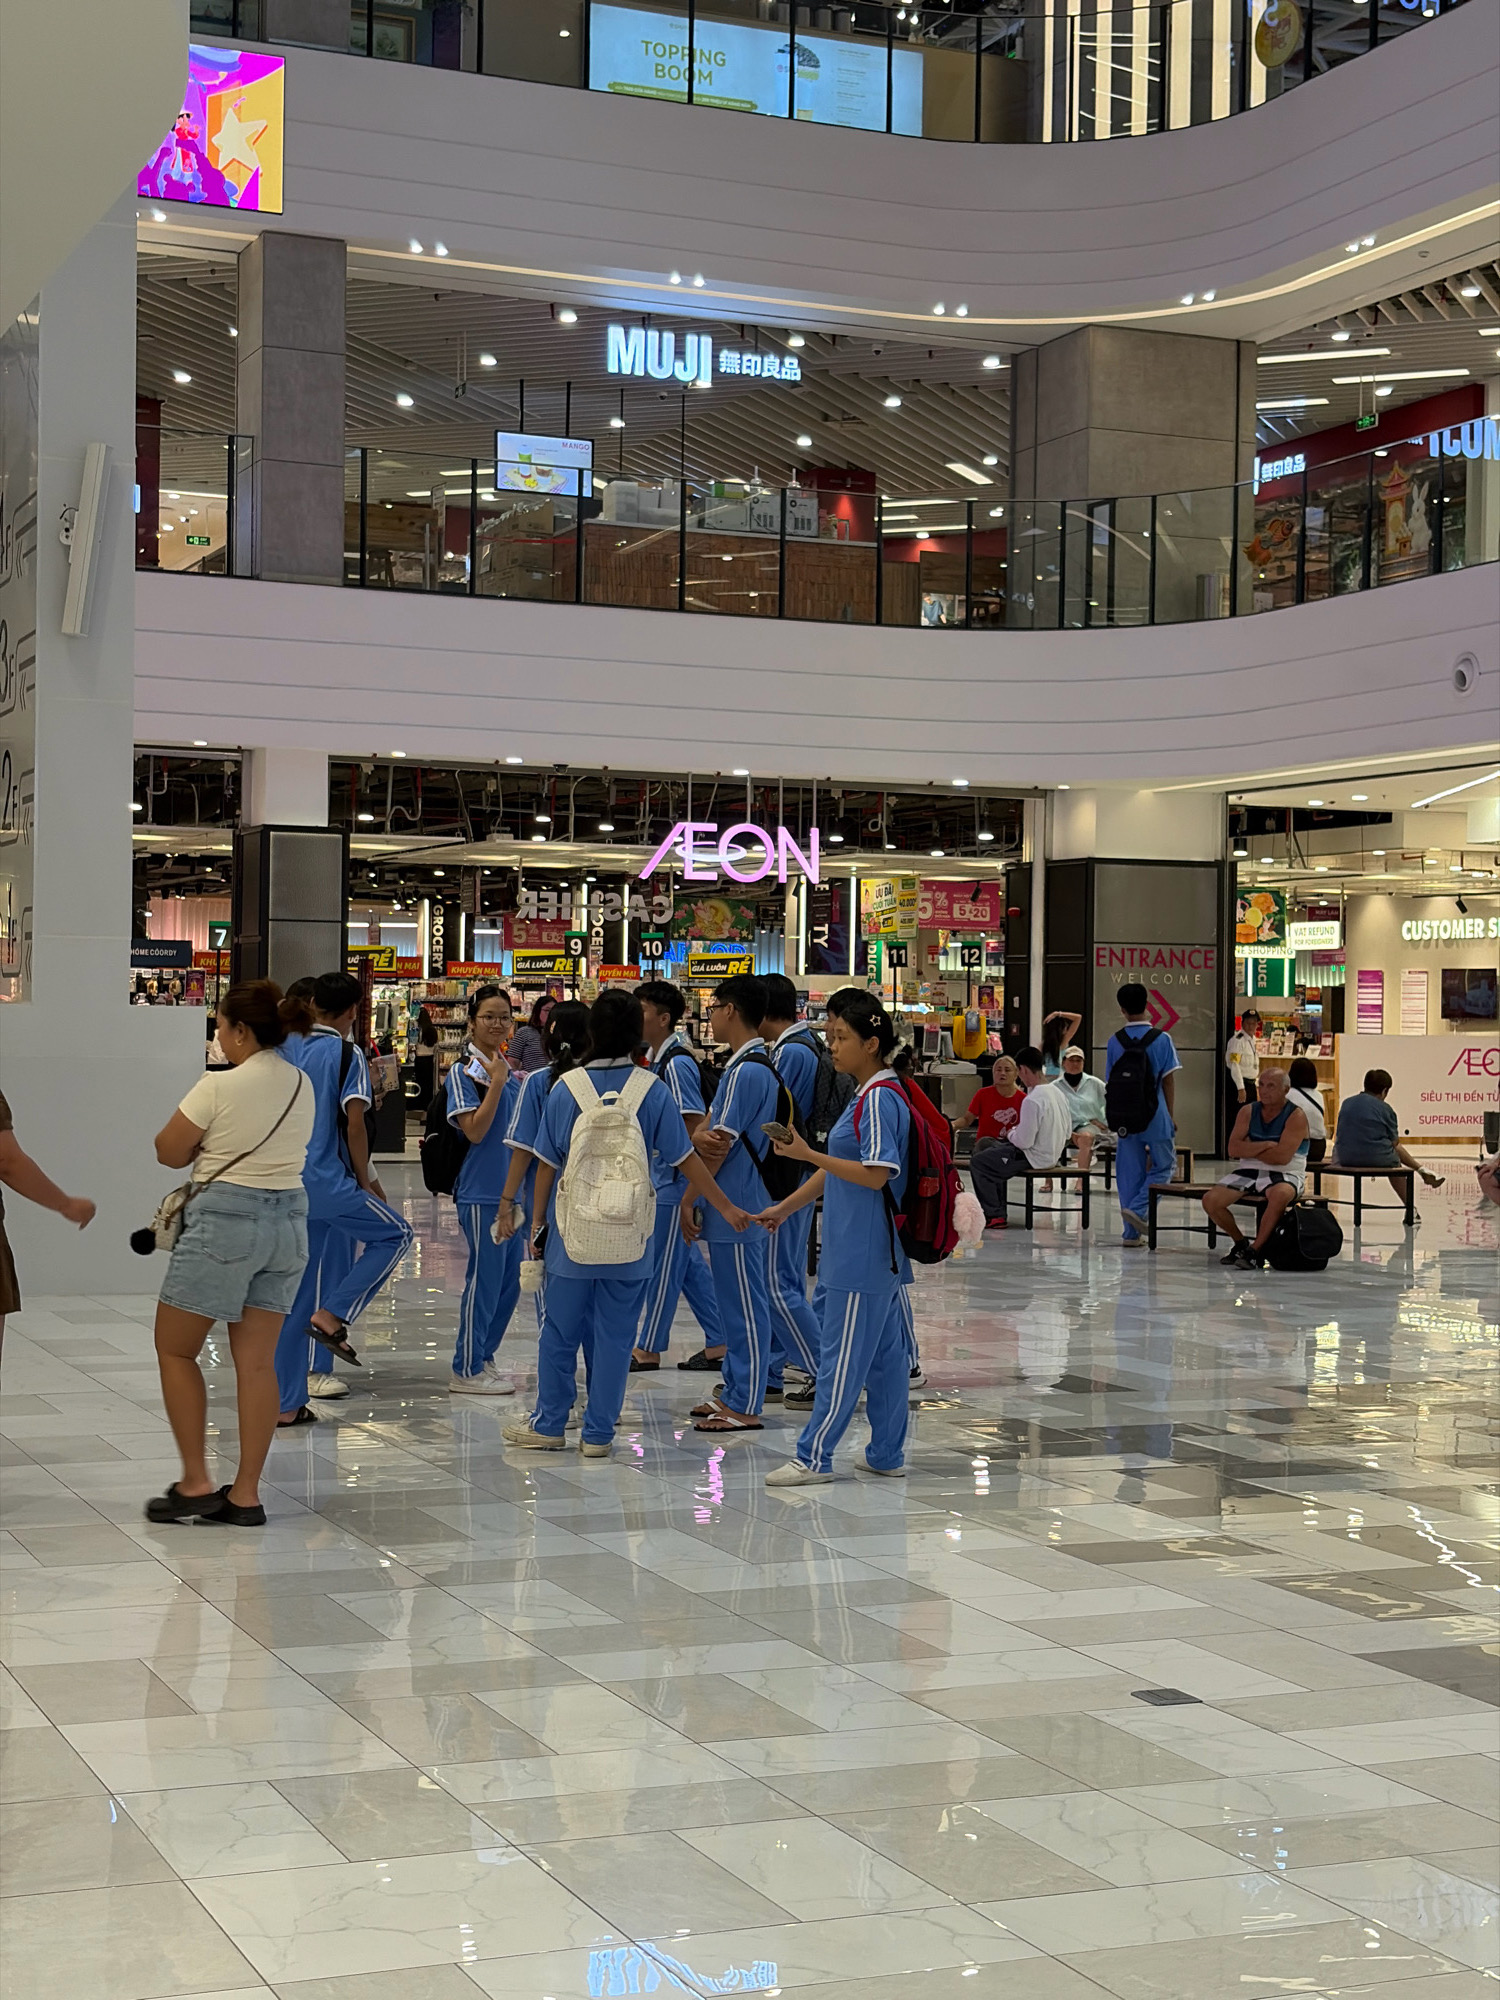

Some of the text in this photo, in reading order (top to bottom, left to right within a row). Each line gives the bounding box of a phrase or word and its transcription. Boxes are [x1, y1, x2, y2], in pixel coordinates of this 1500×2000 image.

[641, 40, 726, 67] TOPPING
[655, 63, 713, 86] BOOM
[608, 325, 712, 384] MUJI
[719, 350, 801, 381] 無印良品
[562, 442, 590, 451] MANGO
[973, 908, 988, 919] 20
[215, 929, 226, 947] 7
[1294, 926, 1335, 936] VAT REFUND
[1402, 918, 1484, 941] CUSTOMER
[433, 905, 444, 973] GROCERY
[570, 938, 582, 956] 9
[642, 941, 663, 957] 10
[890, 949, 906, 964] 11
[962, 948, 980, 964] 12
[1096, 946, 1214, 970] ENTRANCE
[531, 959, 554, 969] LUÔN
[691, 955, 751, 974] GIÁ LUÔN RẺ
[1111, 973, 1201, 986] WELCOME
[1421, 1090, 1442, 1102] SIÊU
[1445, 1093, 1461, 1104] THỊ
[1463, 1090, 1484, 1102] ĐẾN
